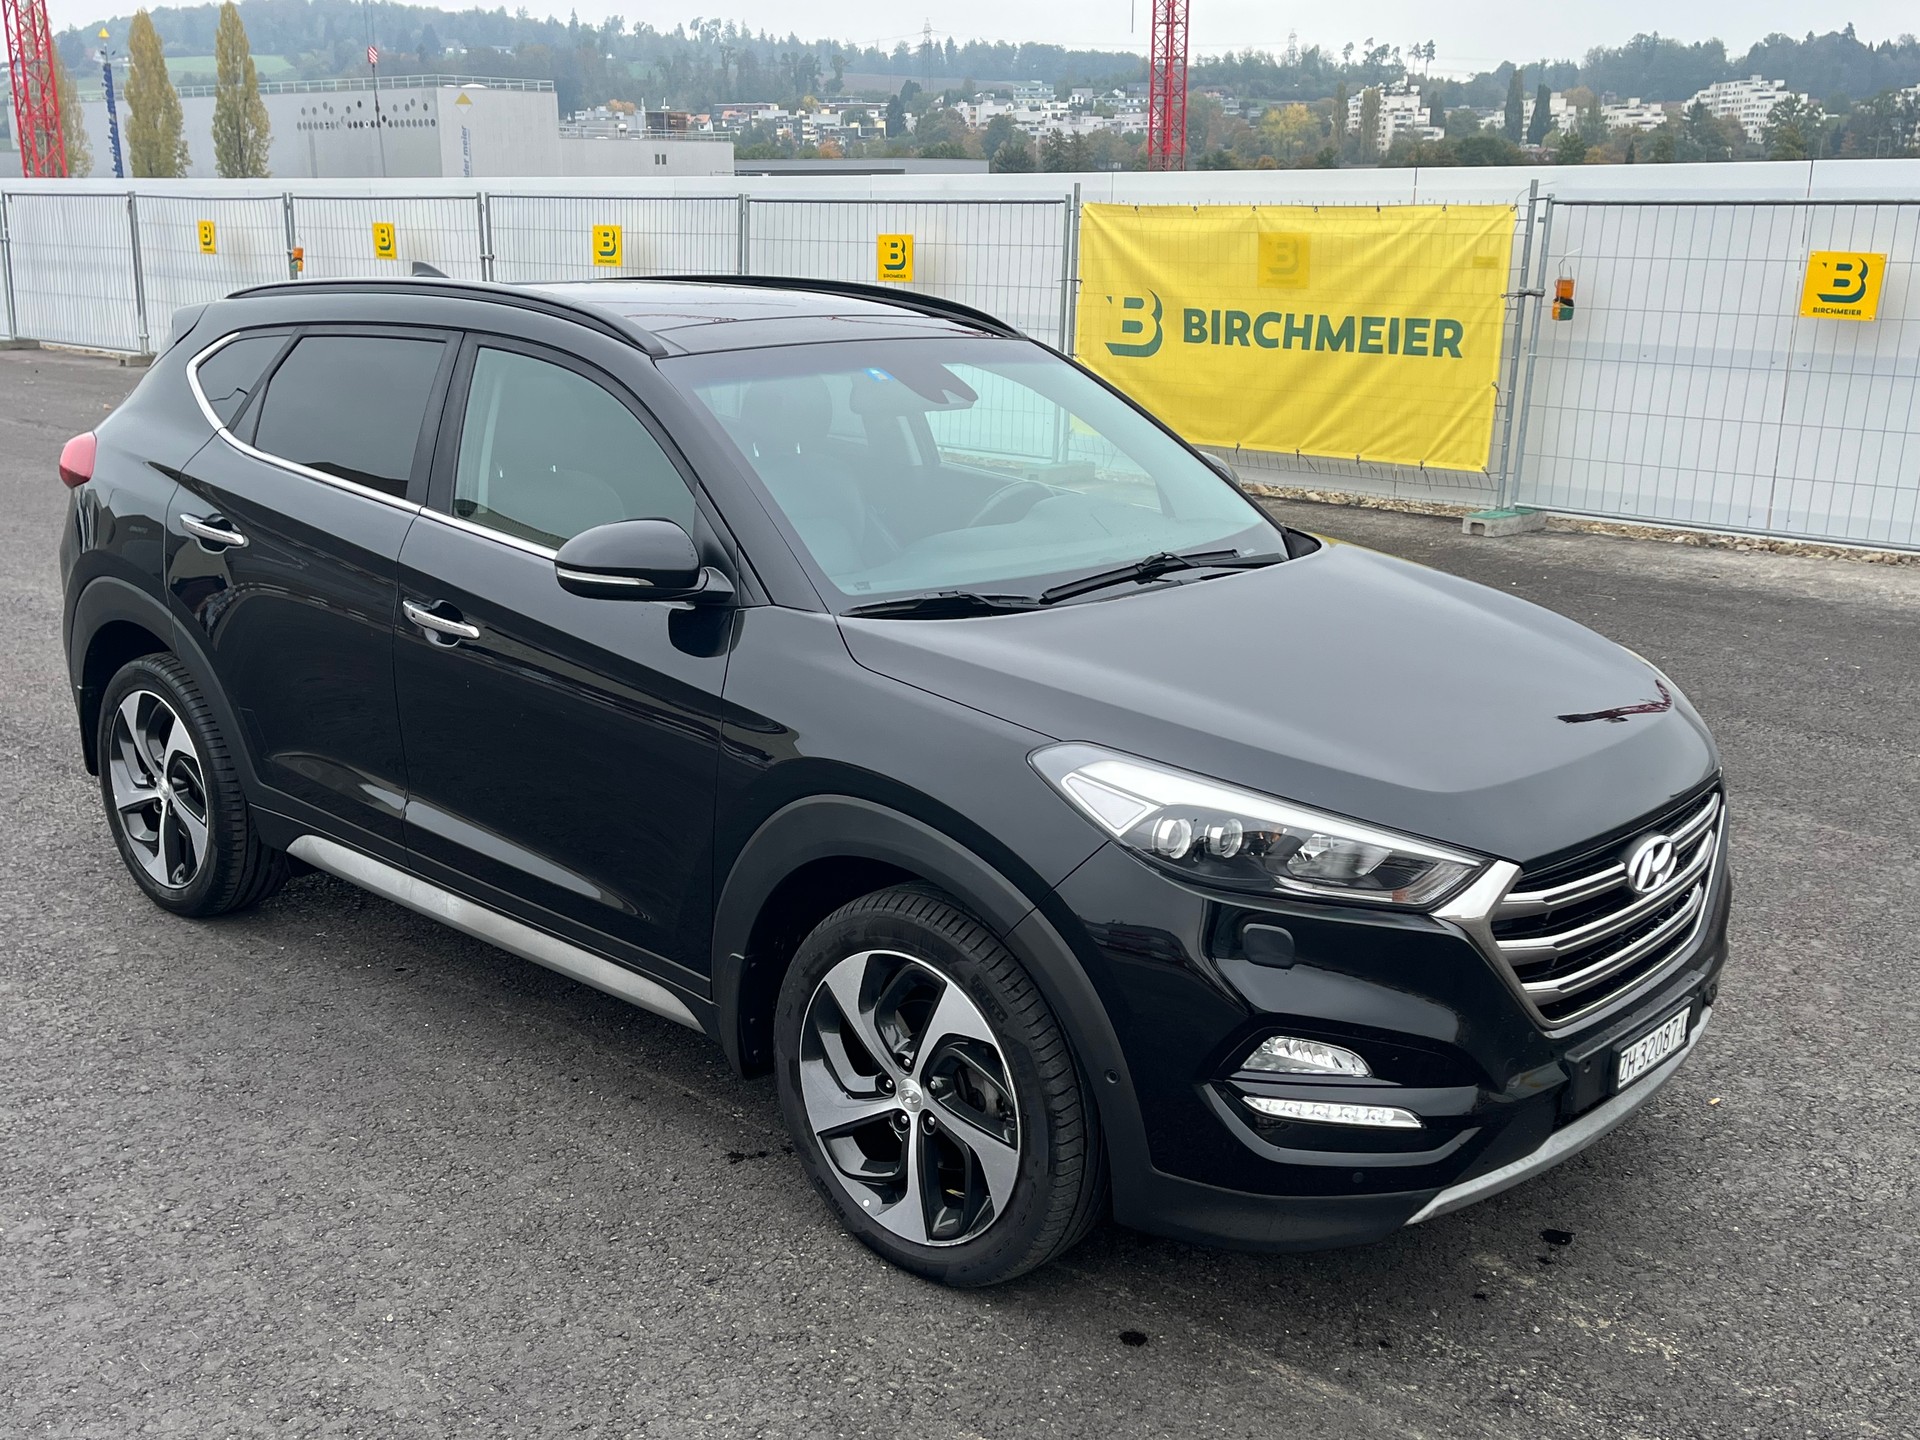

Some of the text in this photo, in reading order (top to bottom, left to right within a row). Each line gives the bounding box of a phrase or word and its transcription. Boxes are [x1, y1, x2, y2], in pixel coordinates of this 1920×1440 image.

[376, 225, 392, 251] B
[597, 227, 616, 257] B
[883, 238, 906, 270] B
[1816, 257, 1869, 303] B
[1104, 288, 1464, 359] B BIRCHMEIER
[1812, 306, 1862, 316] BIRCHMEIER
